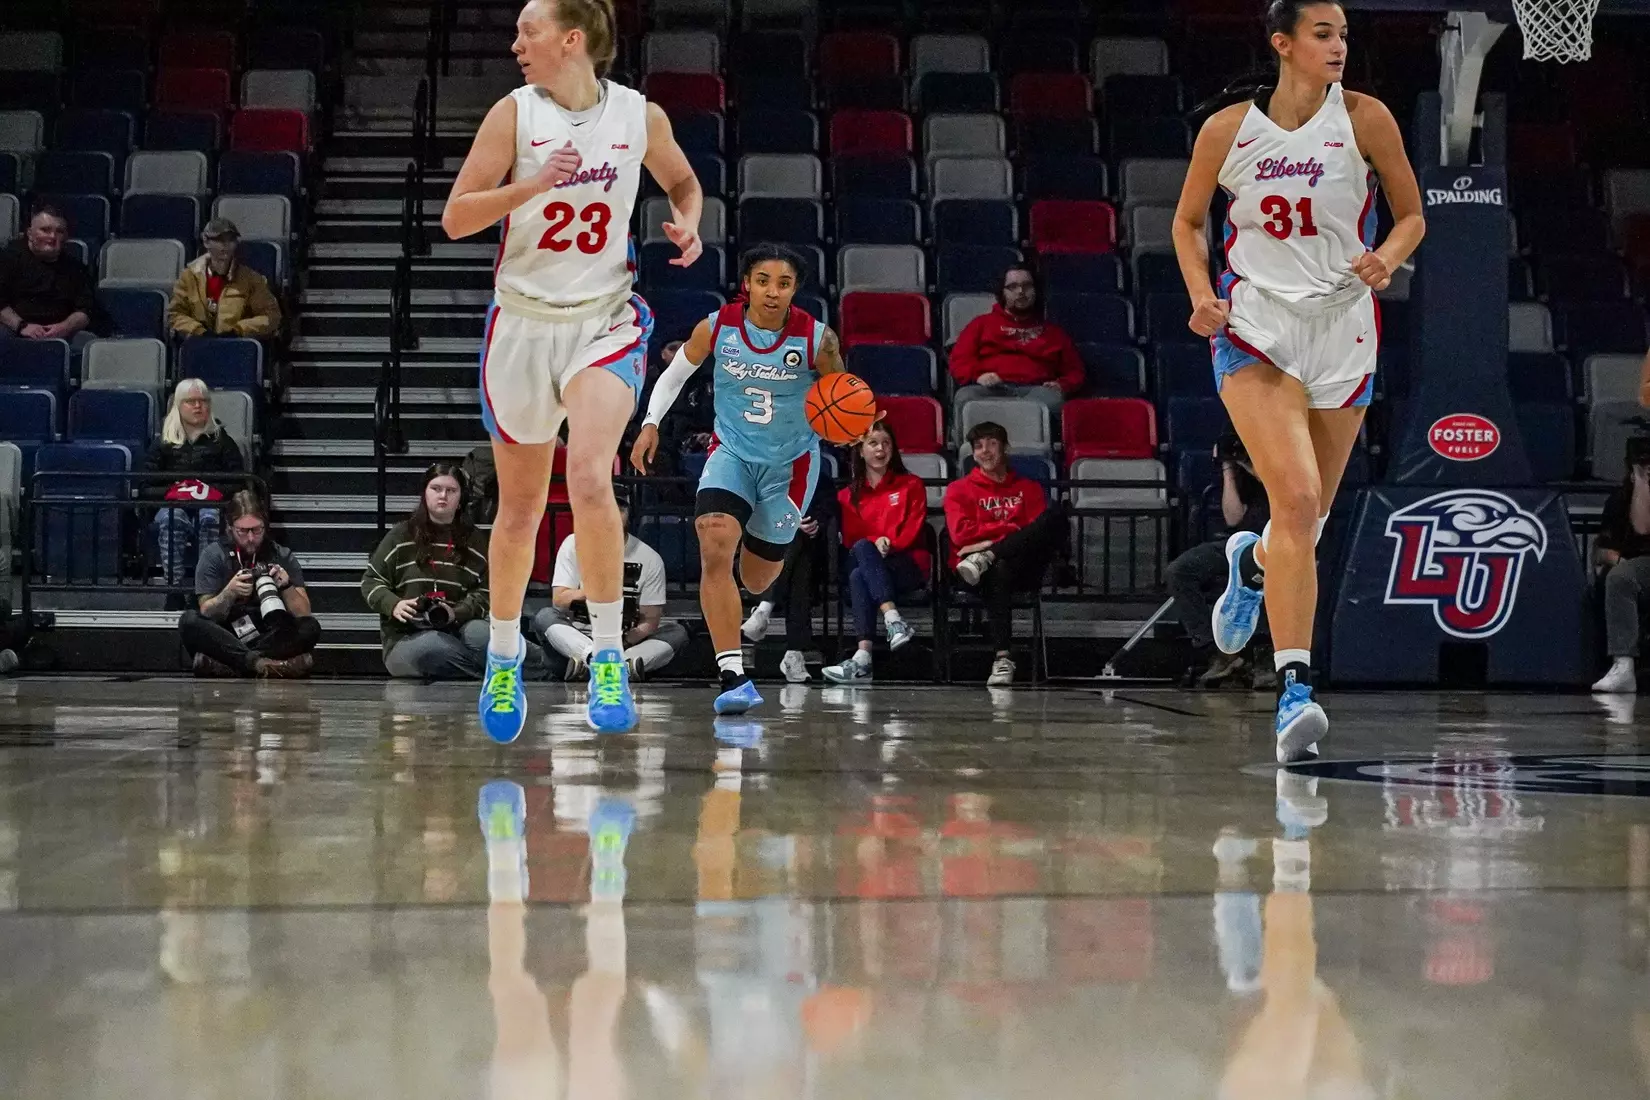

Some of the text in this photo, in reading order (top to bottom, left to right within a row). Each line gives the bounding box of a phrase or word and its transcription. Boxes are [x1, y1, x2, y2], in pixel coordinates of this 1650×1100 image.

[1255, 156, 1325, 187] Liberty
[1426, 188, 1503, 206] SPALDING
[537, 201, 612, 254] 23
[1260, 195, 1318, 241] 31
[743, 387, 773, 425] 3
[1434, 428, 1494, 442] FOSTER
[1448, 445, 1480, 454] FUELS
